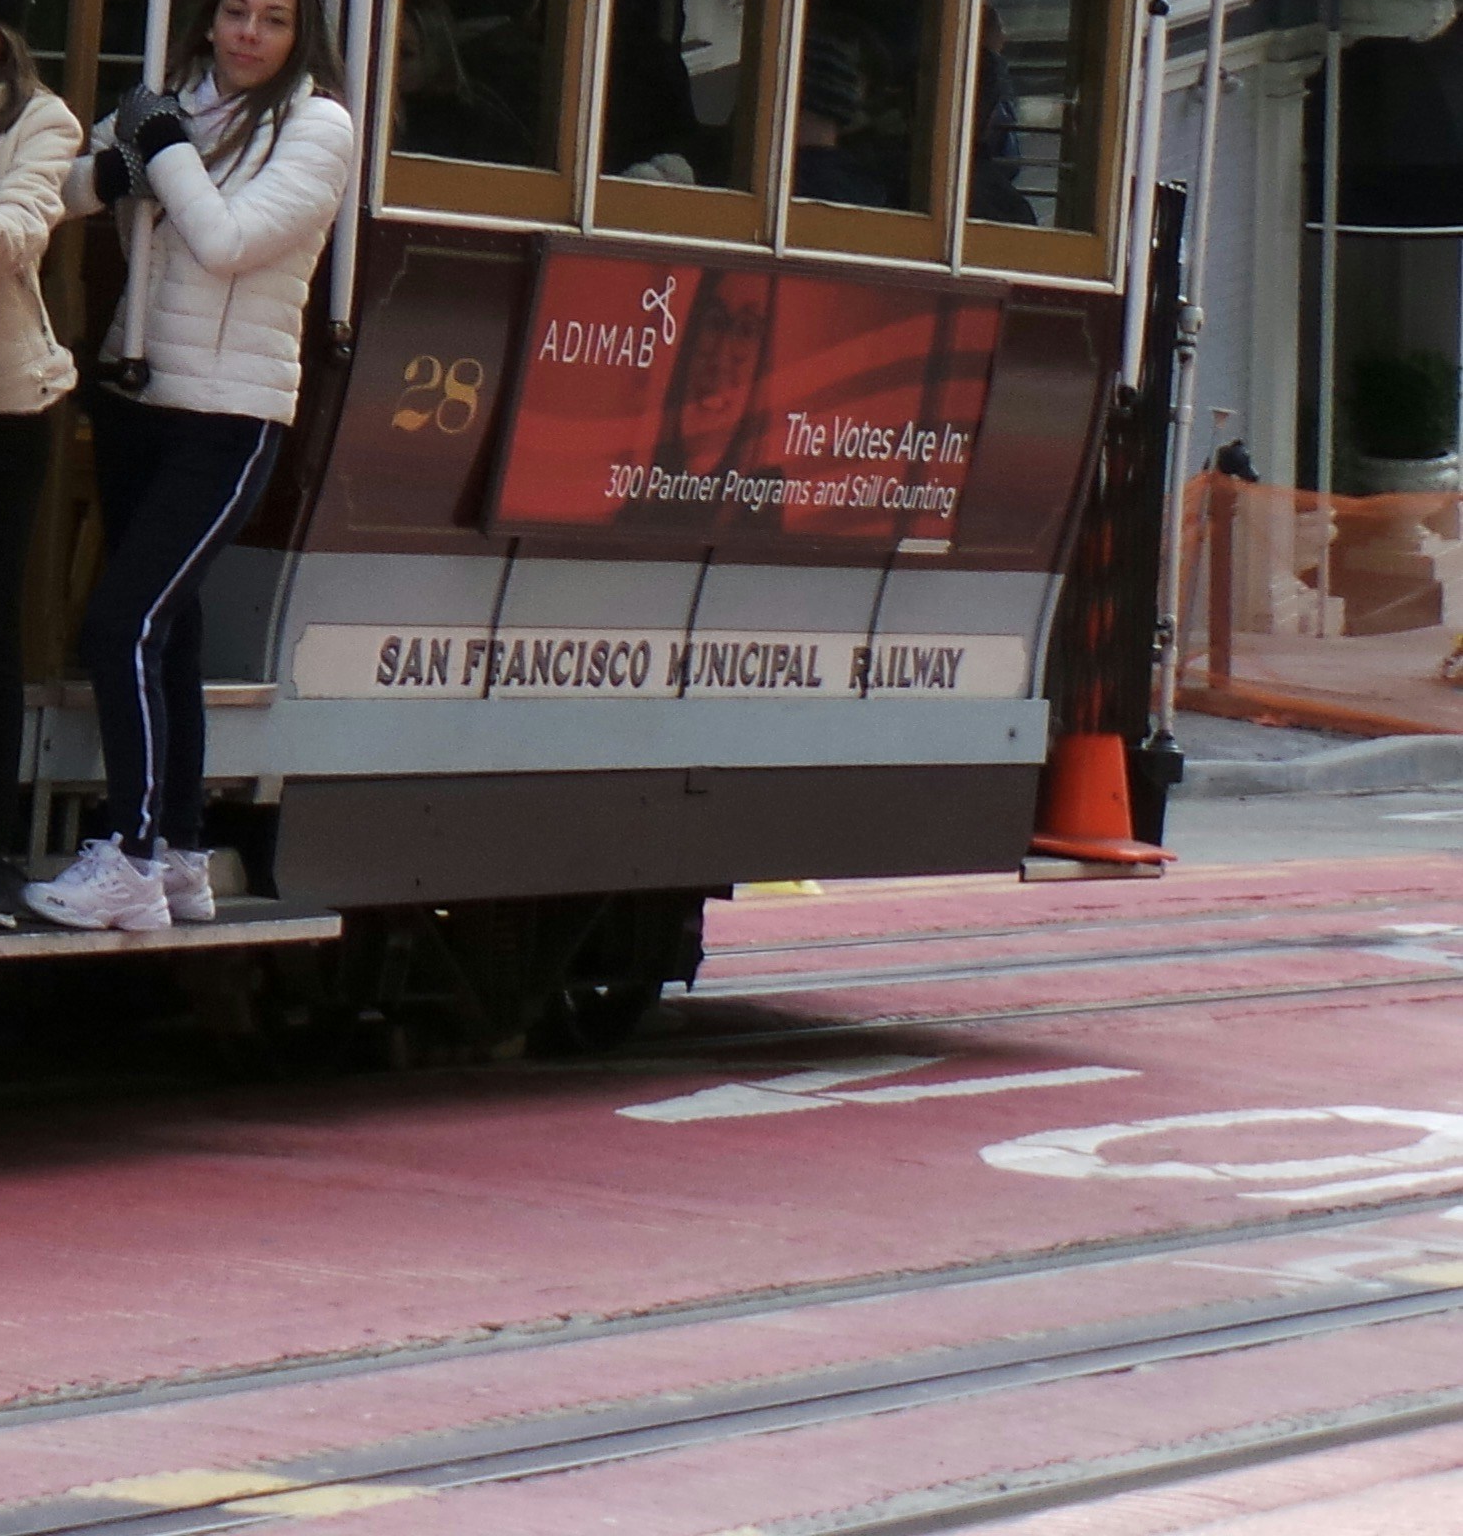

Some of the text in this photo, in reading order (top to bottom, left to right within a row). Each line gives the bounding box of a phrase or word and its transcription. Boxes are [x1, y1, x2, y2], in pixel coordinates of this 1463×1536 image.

[538, 318, 657, 369] ADIMAB
[391, 354, 485, 435] 28
[783, 412, 969, 465] The Votes Are In:
[604, 464, 958, 519] 300 Partner Programs and Still Counting
[375, 634, 452, 687] SAN
[460, 638, 652, 689] FRANCISCO
[847, 643, 966, 690] RAILWAY
